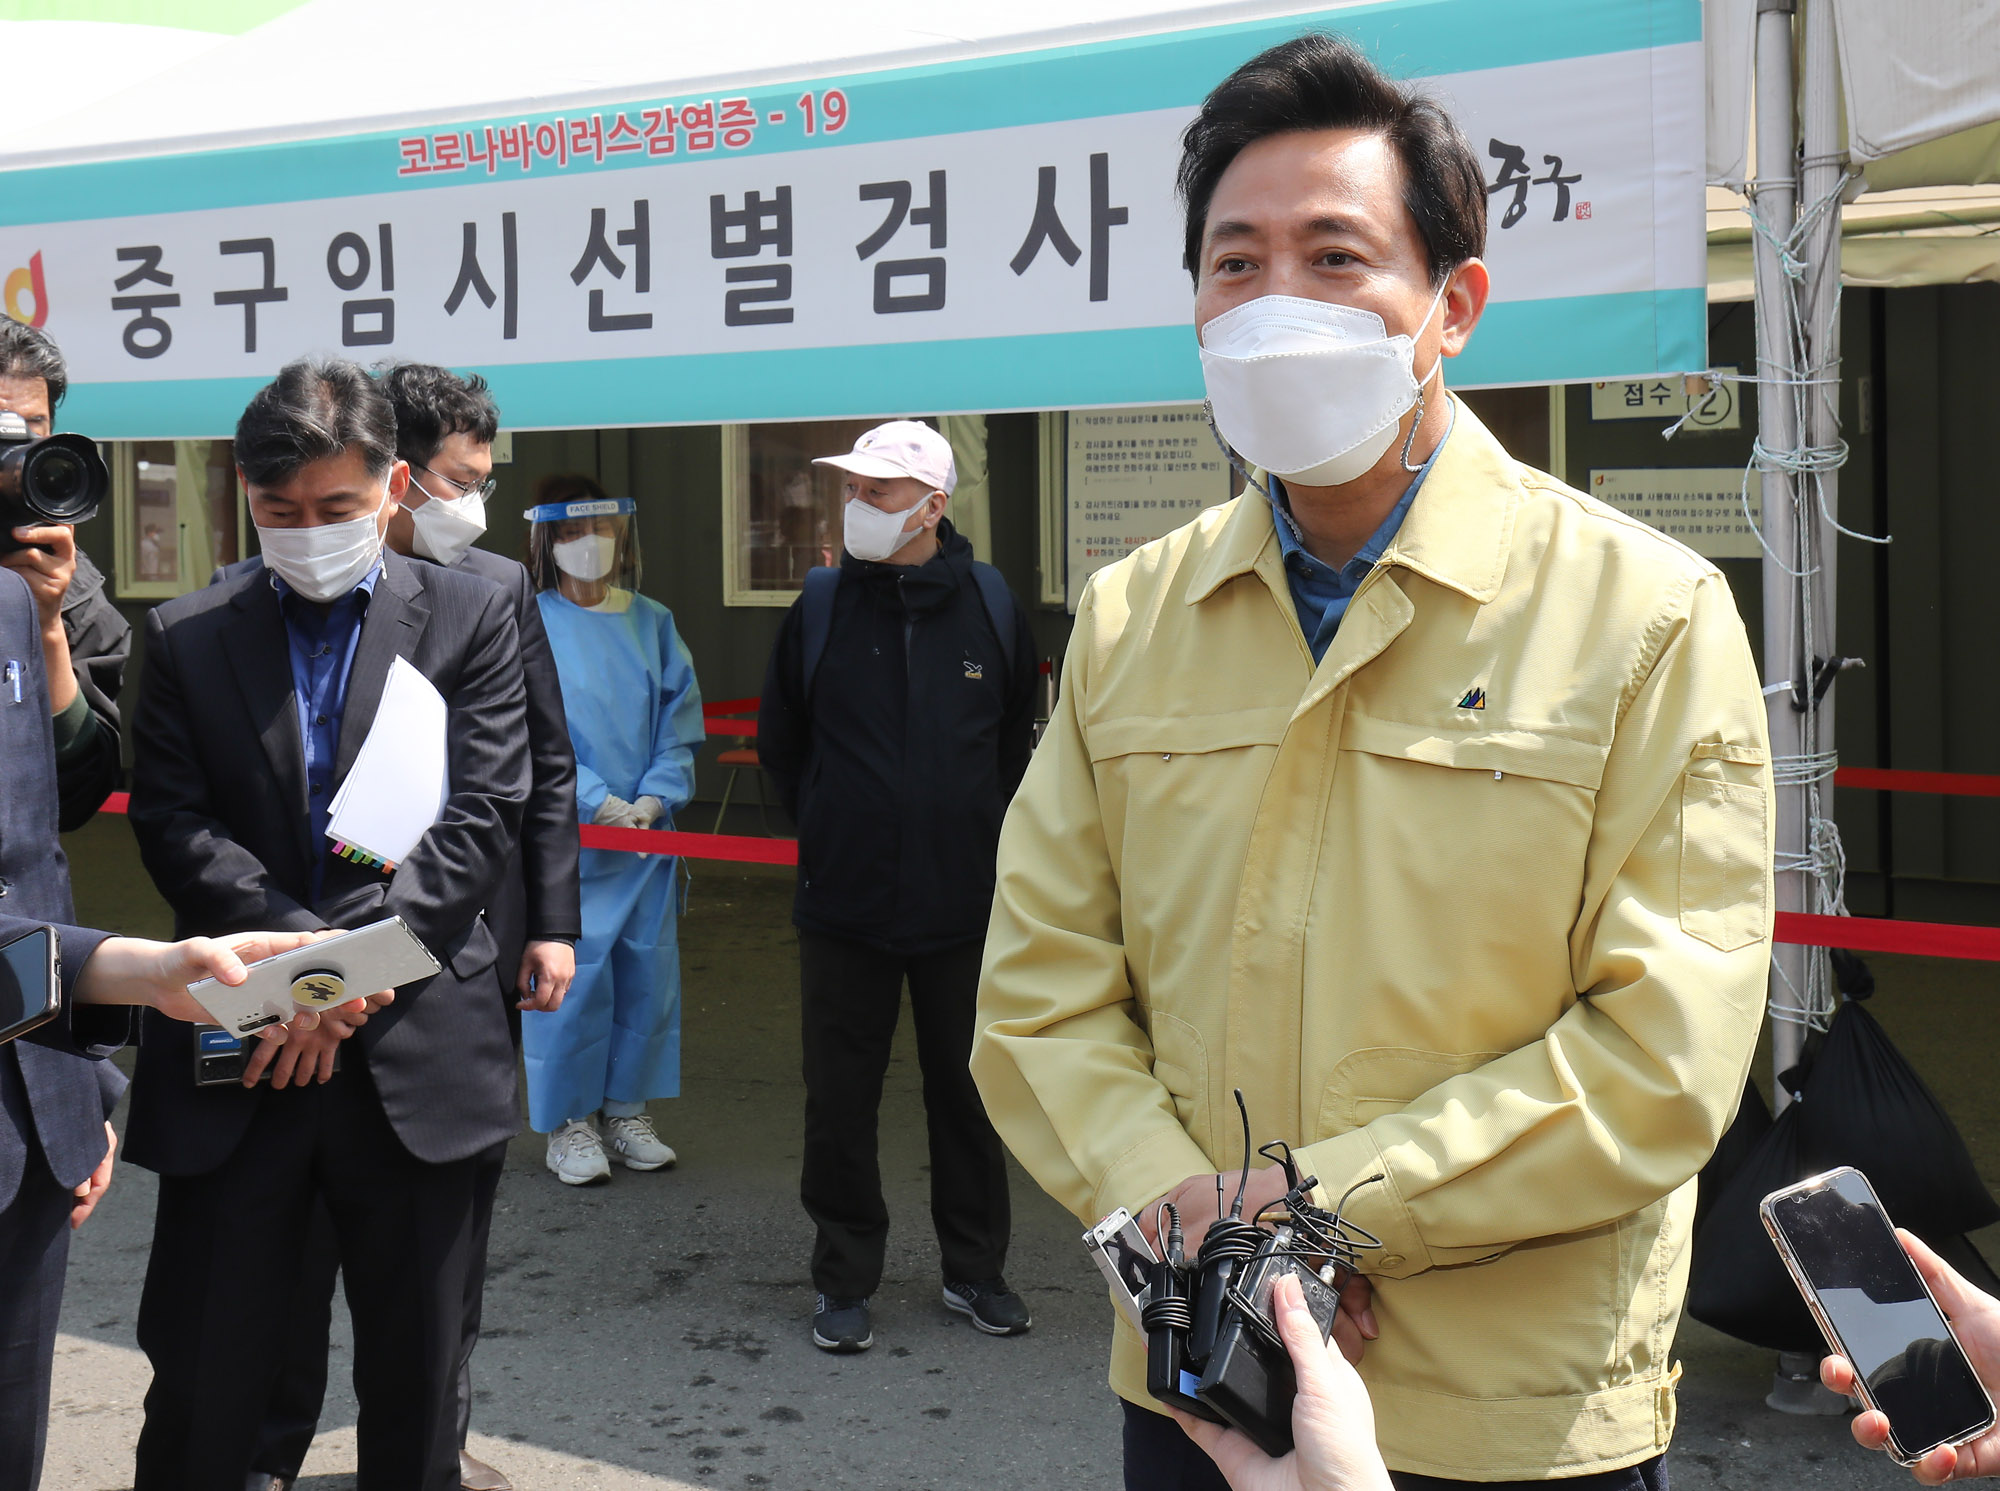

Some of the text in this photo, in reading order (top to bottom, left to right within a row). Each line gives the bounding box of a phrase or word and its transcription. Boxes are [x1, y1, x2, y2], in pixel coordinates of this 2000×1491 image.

[398, 97, 758, 176] 코로나바이러스감염증
[799, 90, 848, 134] 19
[1487, 137, 1582, 229] 중구
[111, 152, 1187, 359] 중구임시선별검사
[1624, 382, 1671, 407] 접수
[0, 426, 26, 434] Canon
[570, 503, 616, 513] FACE SHIELD
